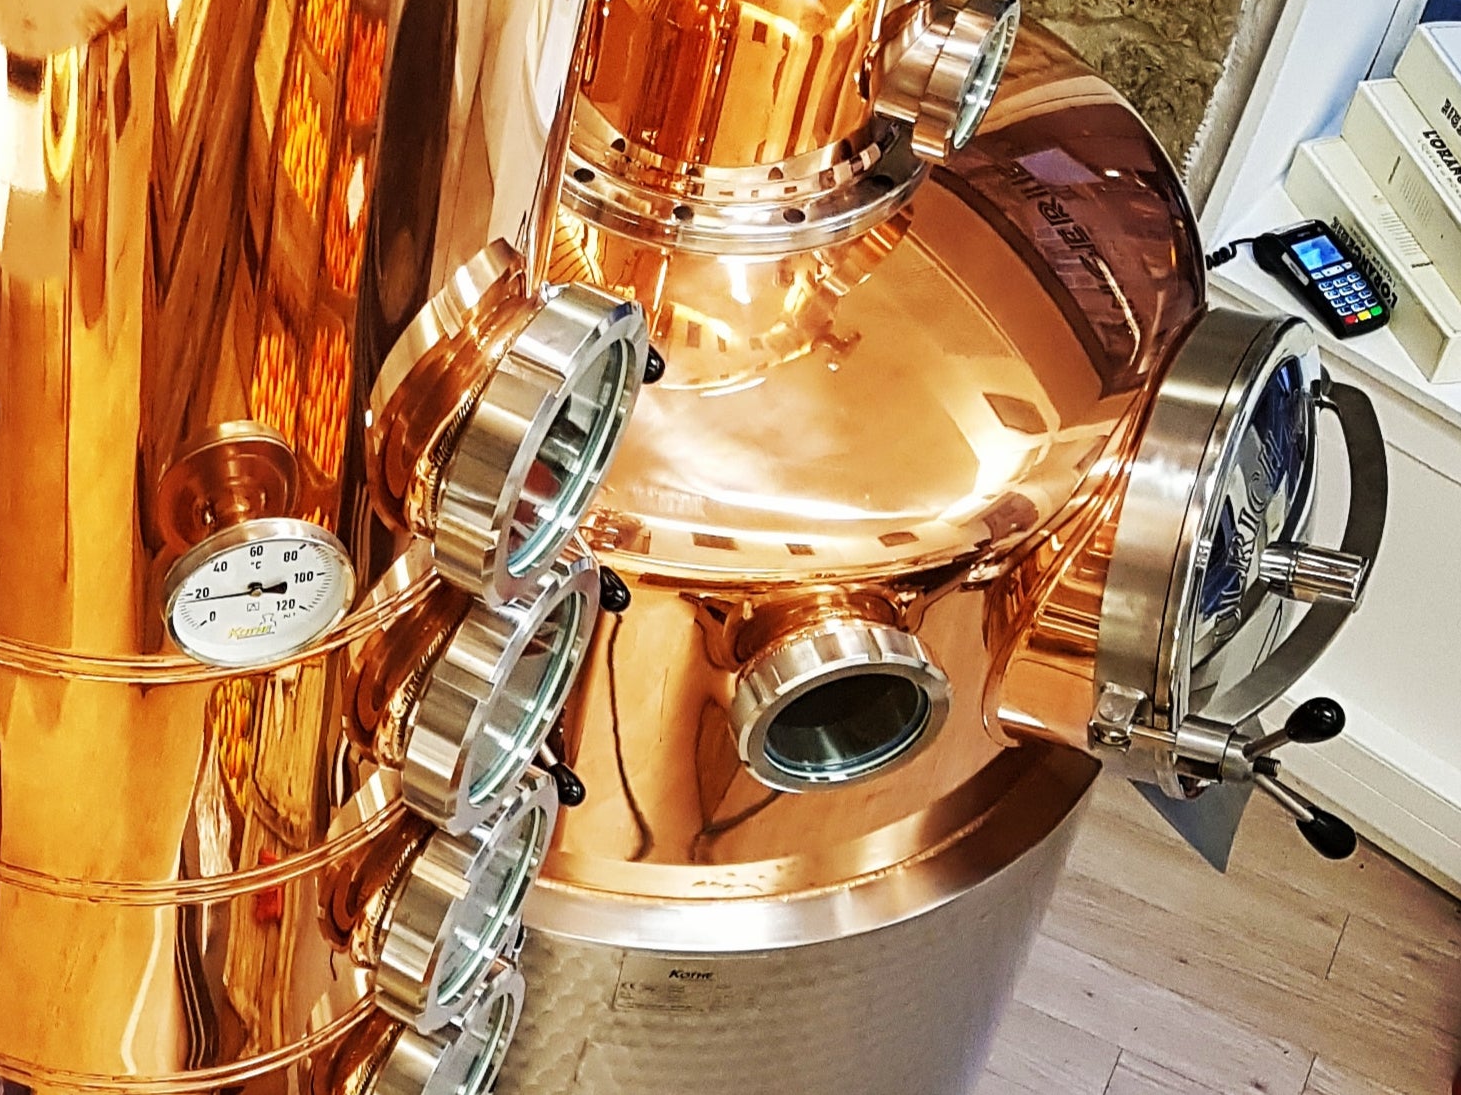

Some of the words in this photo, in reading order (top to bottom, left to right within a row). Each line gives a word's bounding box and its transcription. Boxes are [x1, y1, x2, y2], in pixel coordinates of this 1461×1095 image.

[249, 545, 264, 557] 60
[283, 550, 298, 563] 80
[213, 561, 228, 573] 40
[294, 571, 314, 584] 100
[195, 587, 210, 599] 20
[276, 598, 296, 612] 120
[209, 610, 217, 622] 0
